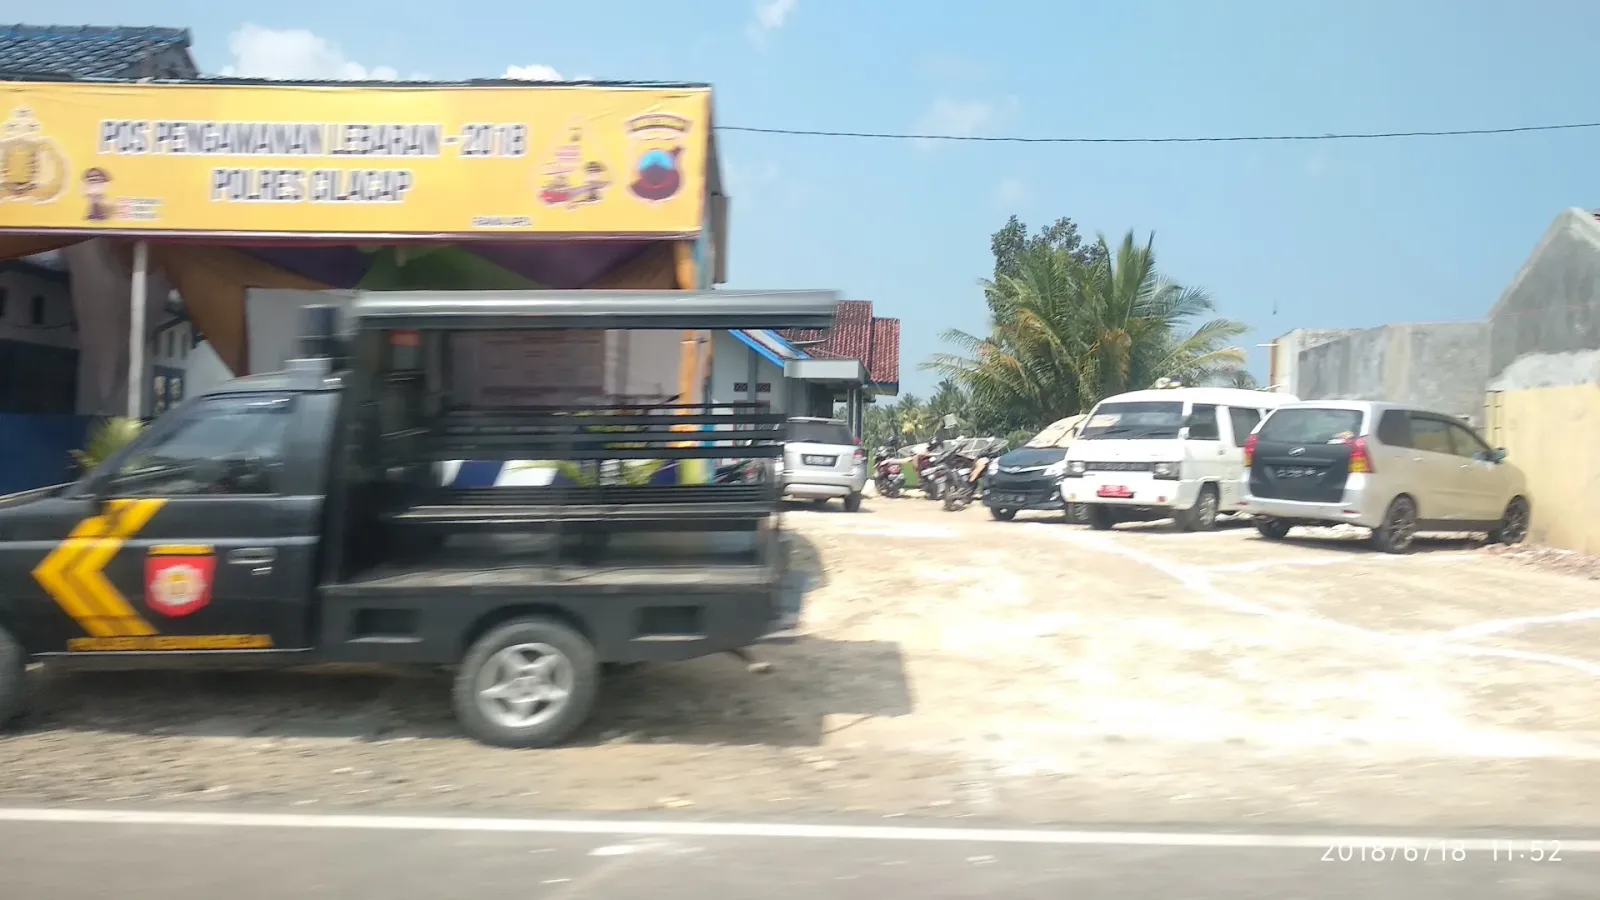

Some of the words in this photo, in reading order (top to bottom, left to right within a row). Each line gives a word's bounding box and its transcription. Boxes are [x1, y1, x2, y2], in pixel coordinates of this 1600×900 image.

[99, 121, 149, 155] POS
[154, 121, 325, 156] PENGAMANAN
[326, 123, 441, 157] LEBARAN
[459, 123, 528, 158] 2018
[211, 167, 303, 202] POLRES
[308, 168, 412, 203] CILACAP
